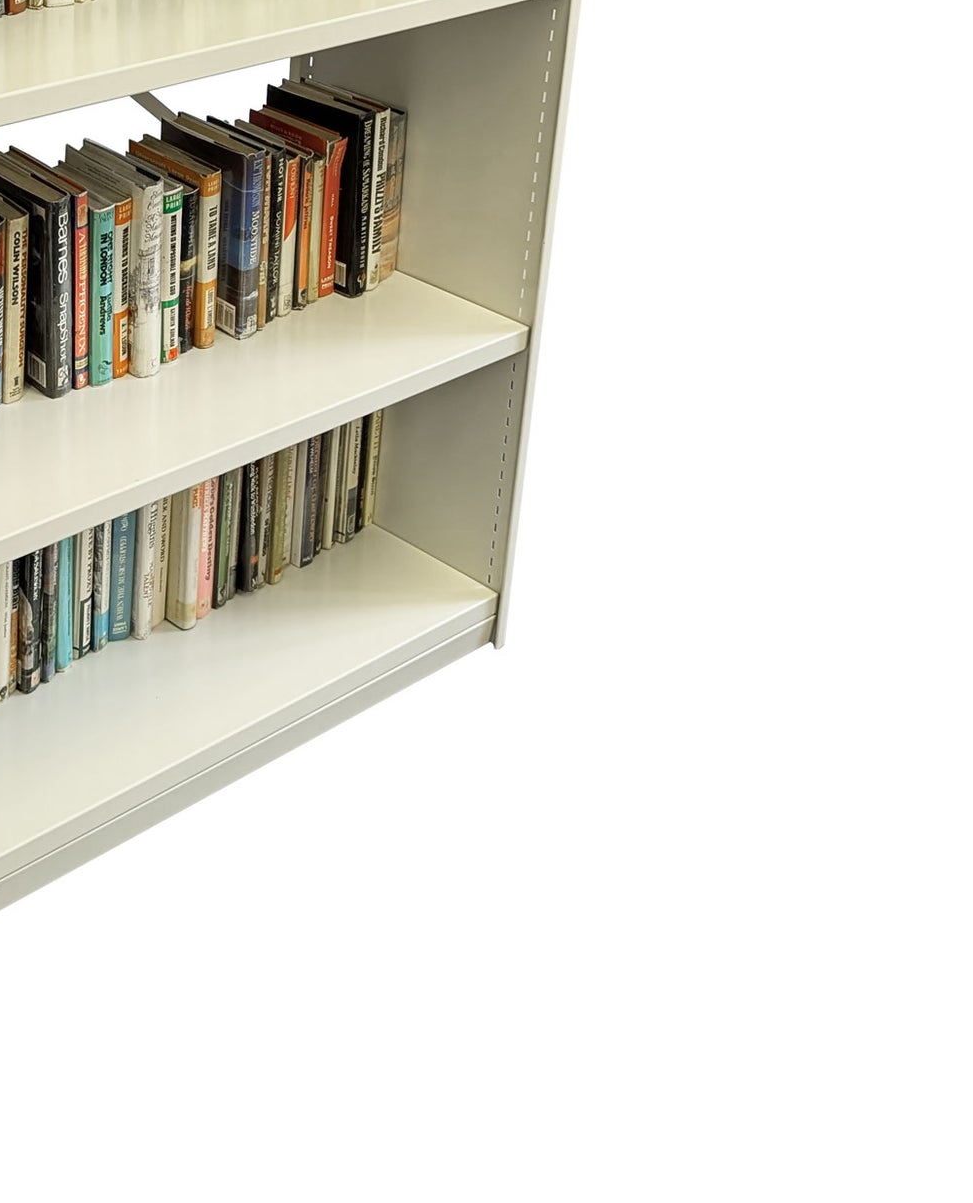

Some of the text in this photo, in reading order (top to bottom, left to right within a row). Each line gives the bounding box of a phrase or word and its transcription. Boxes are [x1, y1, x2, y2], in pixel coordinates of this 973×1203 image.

[377, 116, 387, 171] Richard Condon
[57, 211, 70, 283] Barnes
[207, 205, 217, 270] TO TAME LAND
[248, 210, 260, 265] MOONTIDE
[372, 214, 384, 254] FAMILY
[11, 231, 21, 306] COLIN WILSON
[100, 247, 108, 286] LONDON
[57, 292, 69, 359] SnapShot
[78, 282, 86, 354] PHOENIX
[99, 296, 107, 335] Andrews
[148, 509, 159, 549] Higgins
[205, 543, 213, 581] Destiny
